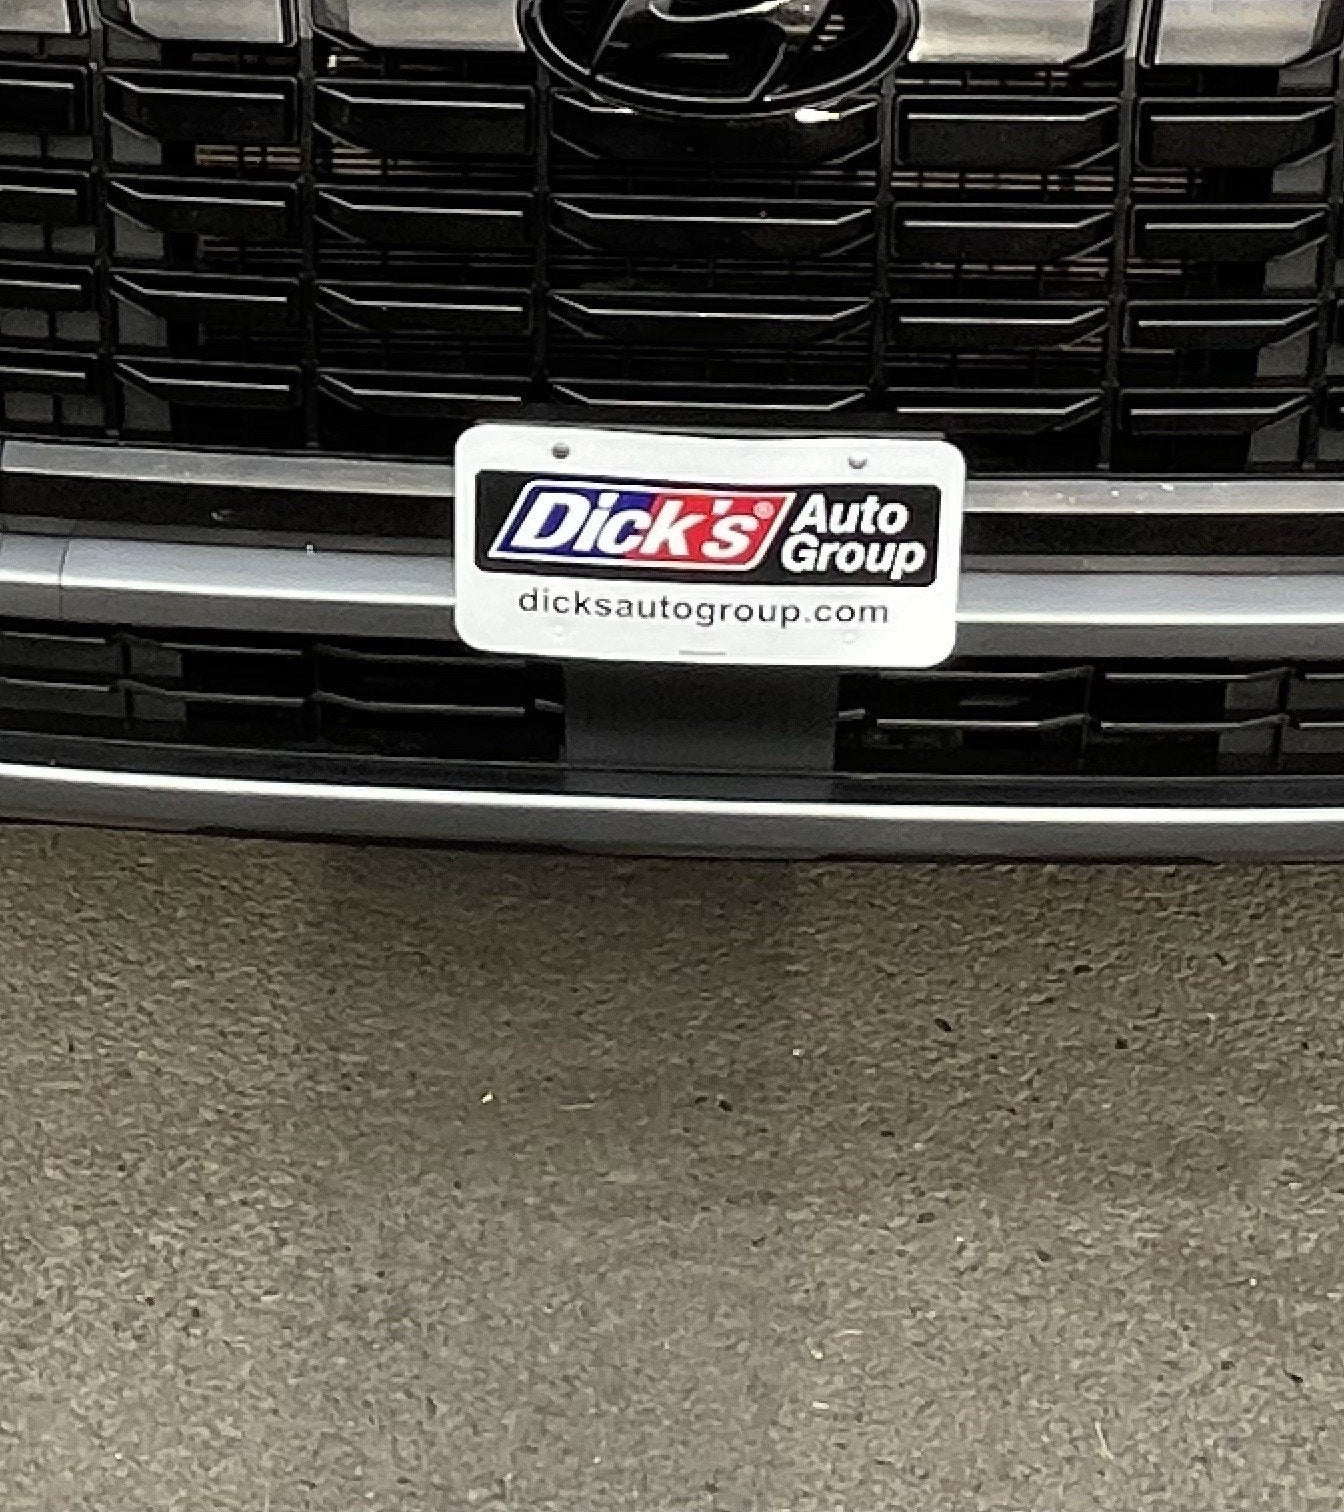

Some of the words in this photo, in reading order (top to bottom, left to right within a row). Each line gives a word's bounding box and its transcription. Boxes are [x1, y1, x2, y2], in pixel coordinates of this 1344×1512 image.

[510, 492, 759, 559] Dick's
[791, 494, 909, 536] Auto
[780, 536, 927, 580] Group
[518, 589, 889, 628] dicksautogroup.com
